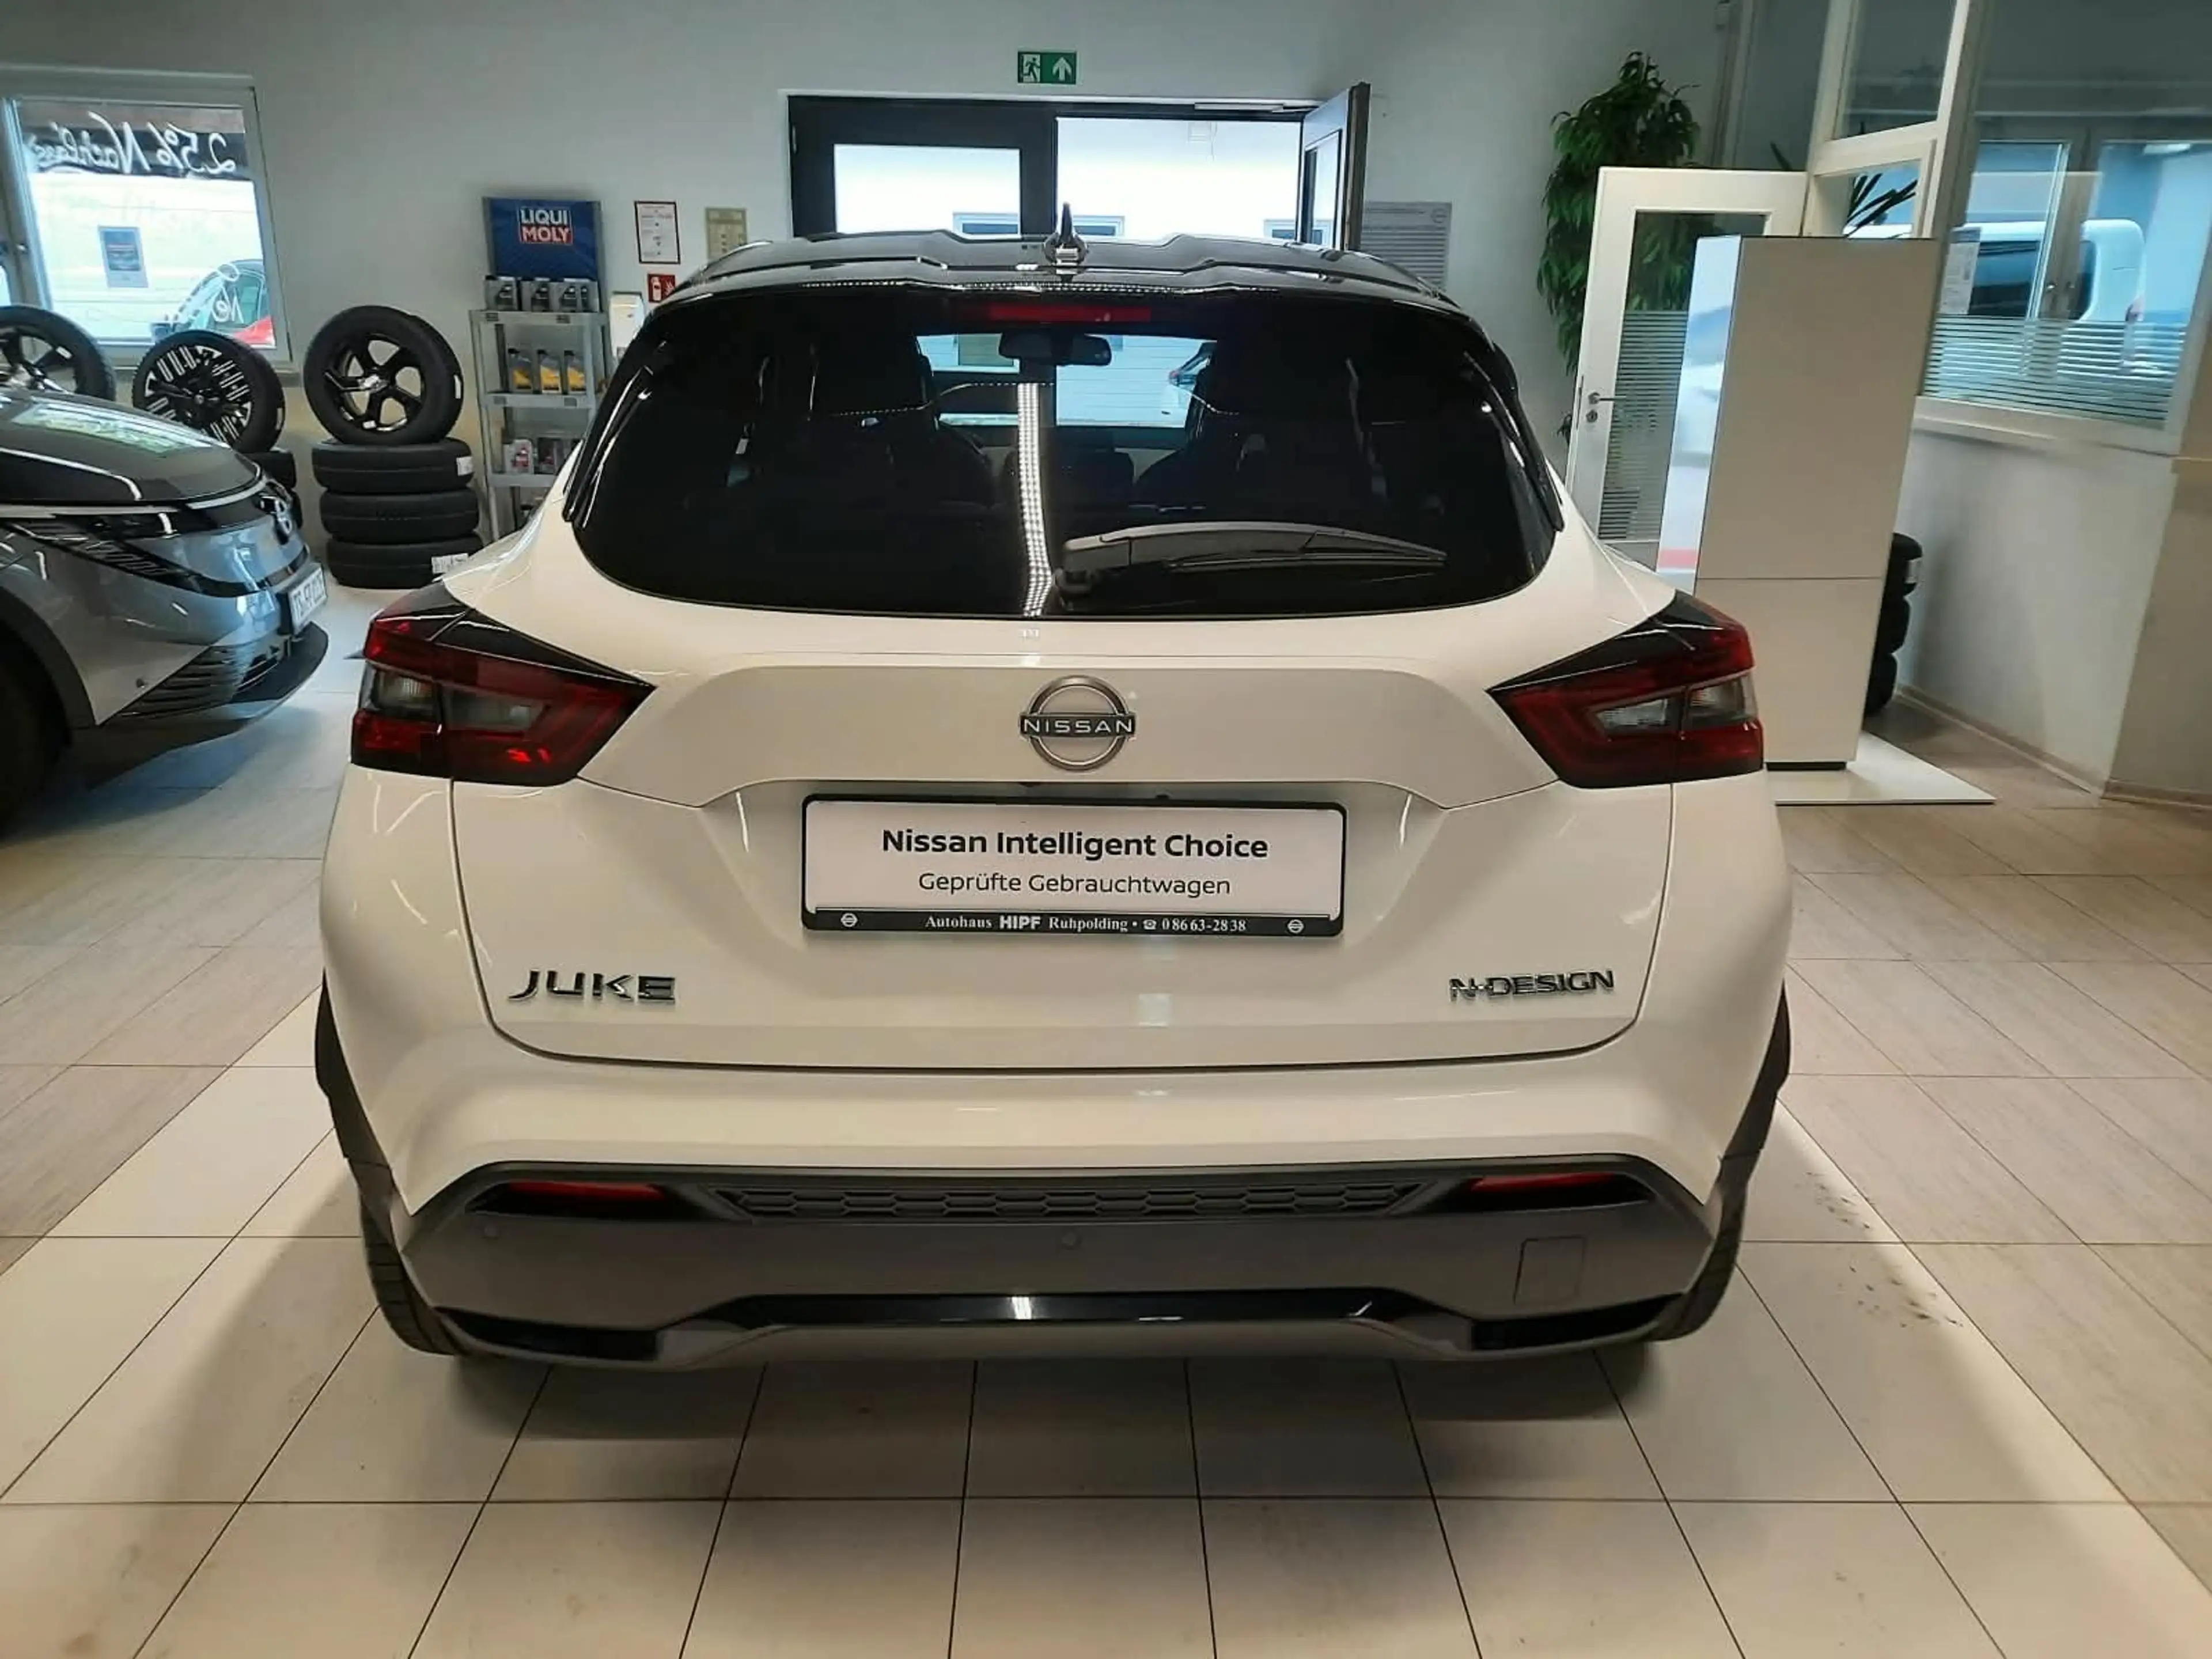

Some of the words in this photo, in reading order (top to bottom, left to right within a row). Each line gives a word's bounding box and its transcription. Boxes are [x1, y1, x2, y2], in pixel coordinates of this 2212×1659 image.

[520, 209, 568, 226] LIQUI
[522, 226, 570, 241] MOLY
[1023, 718, 1132, 733] NISSAN
[882, 830, 987, 853] Nissan
[997, 832, 1156, 861] Intelligent
[1165, 834, 1268, 858] Choice
[919, 872, 1021, 895] Geprüfte
[1028, 874, 1230, 898] Gebrauchtwagen
[925, 915, 992, 928] Autohaus
[999, 915, 1040, 930] HIPF
[1048, 916, 1128, 932] Ruhpolding
[507, 969, 676, 1004] JUKE
[1449, 970, 1615, 1001] N-DESIGN
